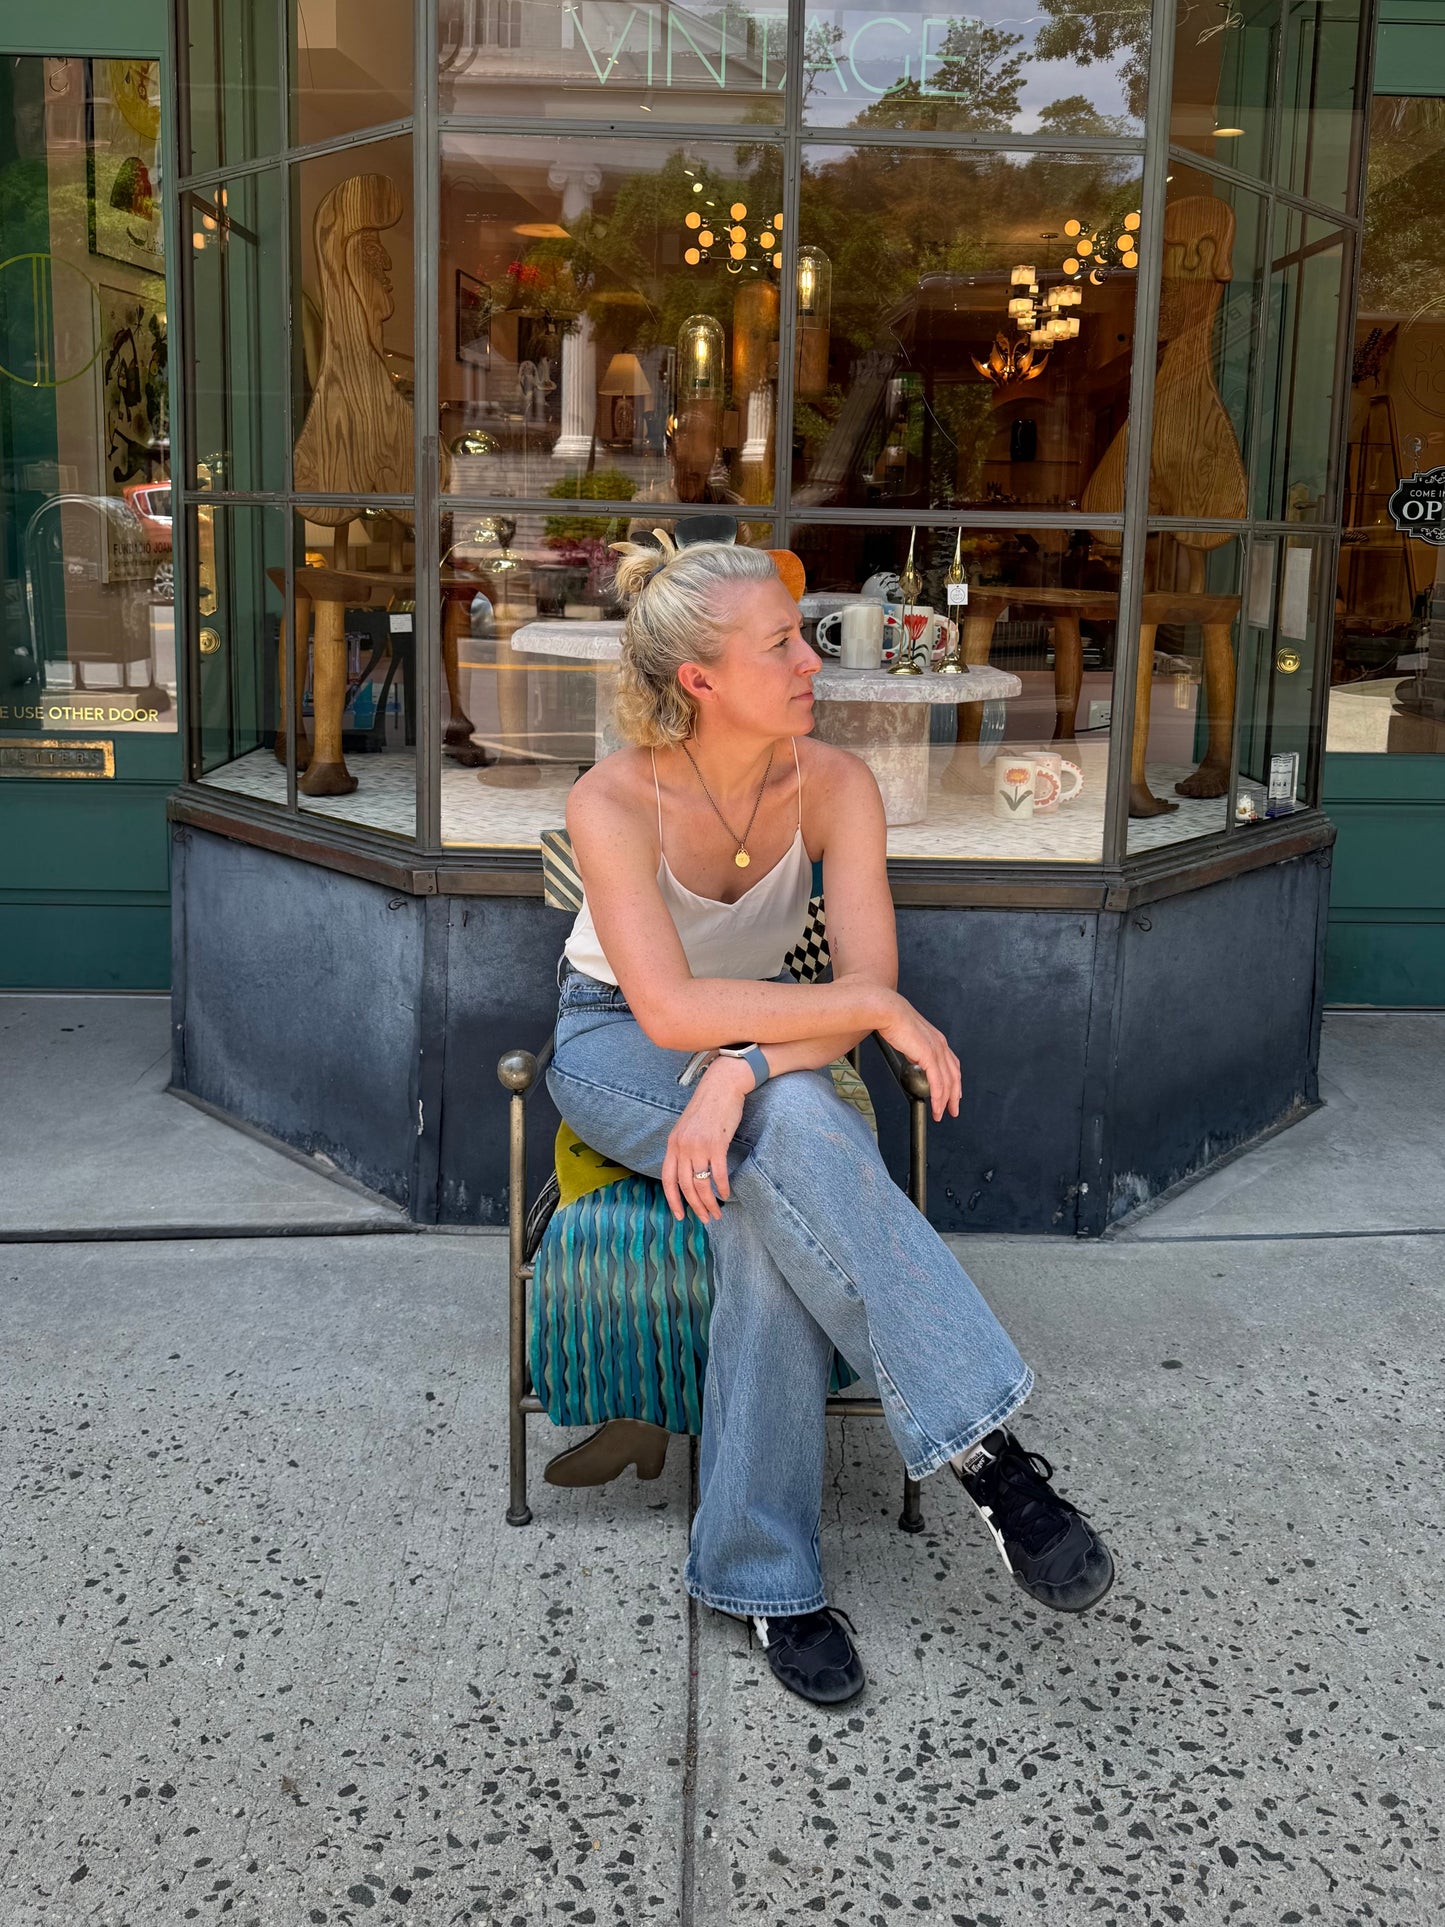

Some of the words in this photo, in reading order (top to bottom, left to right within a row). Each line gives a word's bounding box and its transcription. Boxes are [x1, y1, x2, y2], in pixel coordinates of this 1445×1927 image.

[570, 7, 974, 97] VINTAGE
[1409, 489, 1436, 498] COME
[1402, 500, 1445, 521] OP
[14, 706, 44, 719] USE
[48, 707, 104, 720] OTHER
[109, 707, 159, 722] DOOR
[4, 750, 101, 764] LETTERS
